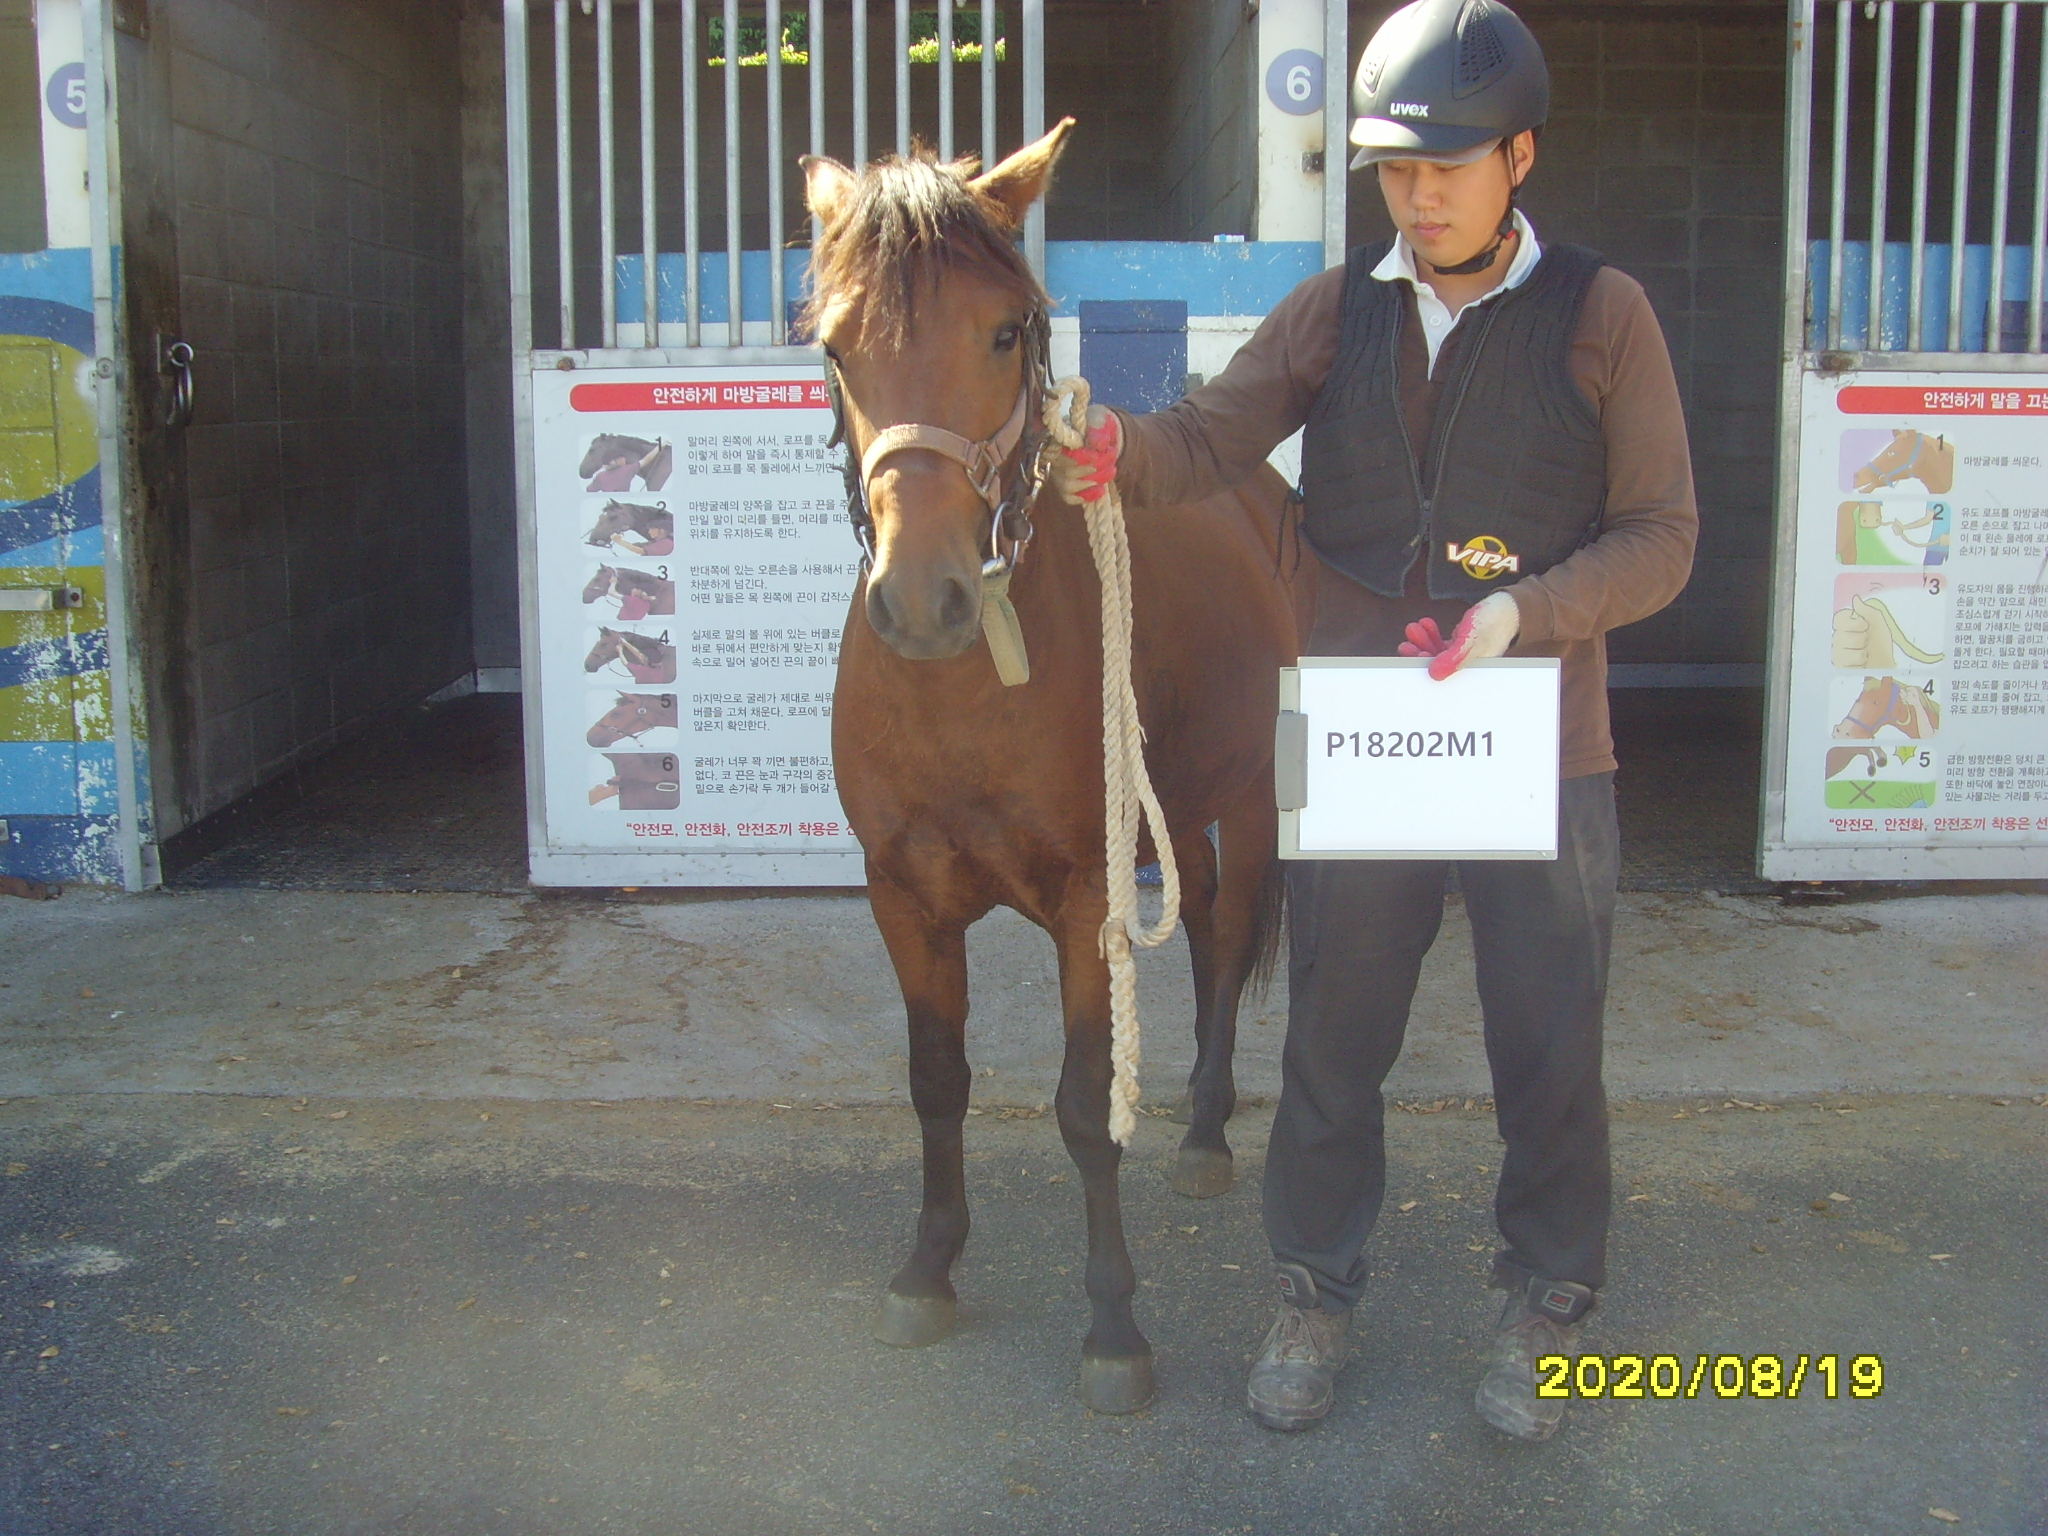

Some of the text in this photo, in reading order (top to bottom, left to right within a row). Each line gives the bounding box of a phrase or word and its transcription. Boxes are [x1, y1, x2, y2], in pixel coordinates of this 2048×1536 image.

[1286, 65, 1312, 101] 6
[66, 79, 86, 114] 5
[1390, 102, 1430, 118] uvex
[653, 386, 803, 404] 안전하게 마방굴레를
[1924, 392, 2021, 409] 안전하게 말을
[655, 436, 663, 451] 1
[688, 436, 717, 447] 말머리
[722, 435, 751, 446] 왼쪽에
[783, 435, 814, 445] 로프를
[818, 435, 827, 447] 목
[1936, 433, 1944, 451] 1
[688, 448, 839, 461] 이렇게 하여 말을 즉시 통제할 수
[688, 464, 708, 475] 말이
[712, 464, 742, 474] 로프를
[746, 463, 756, 474] 목
[760, 462, 800, 474] 둘레에서
[656, 500, 667, 515] 2
[689, 499, 835, 512] 마방굴레의 양쪽을 잡고 코 끈을
[1932, 503, 1945, 521] 2
[689, 514, 709, 525] 만일
[713, 514, 732, 525] 말이
[799, 513, 828, 524] 머리를
[690, 528, 719, 539] 위치를
[723, 528, 773, 539] 유지하도록
[1447, 542, 1520, 572] VIPA
[657, 564, 669, 581] 3
[690, 564, 842, 576] 반대쪽에 있는 오른손을 사용해서
[691, 579, 730, 590] 차분하게
[1928, 578, 1941, 596] 3
[691, 592, 816, 603] 어떤 말들은 목 왼쪽에 끈이
[658, 629, 670, 645] 4
[692, 629, 841, 640] 실제로 말의 볼 위에 있는 버클로
[692, 642, 823, 655] 바로 뒤에서 편안하게 맞는지
[692, 656, 827, 668] 속으로 밀어 넣어진 끈의 끝이
[1923, 679, 1935, 696] 4
[660, 693, 672, 709] 5
[693, 693, 810, 704] 마지막으로 굴레가 제대로
[694, 707, 723, 718] 버클을
[727, 707, 746, 717] 고쳐
[788, 706, 817, 717] 로프에
[694, 720, 723, 731] 않은지
[1327, 731, 1492, 758] P18202M1
[662, 756, 674, 772] 6
[694, 757, 724, 767] 굴레가
[729, 756, 748, 767] 너무
[752, 756, 761, 767] 꽉
[766, 756, 785, 767] 끼면
[1919, 751, 1931, 768] 5
[721, 771, 732, 779] 코
[735, 770, 755, 780] 끈은
[759, 769, 779, 780] 눈과
[783, 769, 813, 782] 구각의
[696, 783, 830, 794] 밑으로 손가락 두 개가 들어갈
[685, 823, 730, 837] 안전화,
[737, 823, 792, 836] 안전조끼
[798, 822, 839, 836] 착용은
[1885, 818, 1927, 831] 안전화,
[1934, 817, 1985, 831] 안전조끼
[1992, 817, 2030, 831] 착용은
